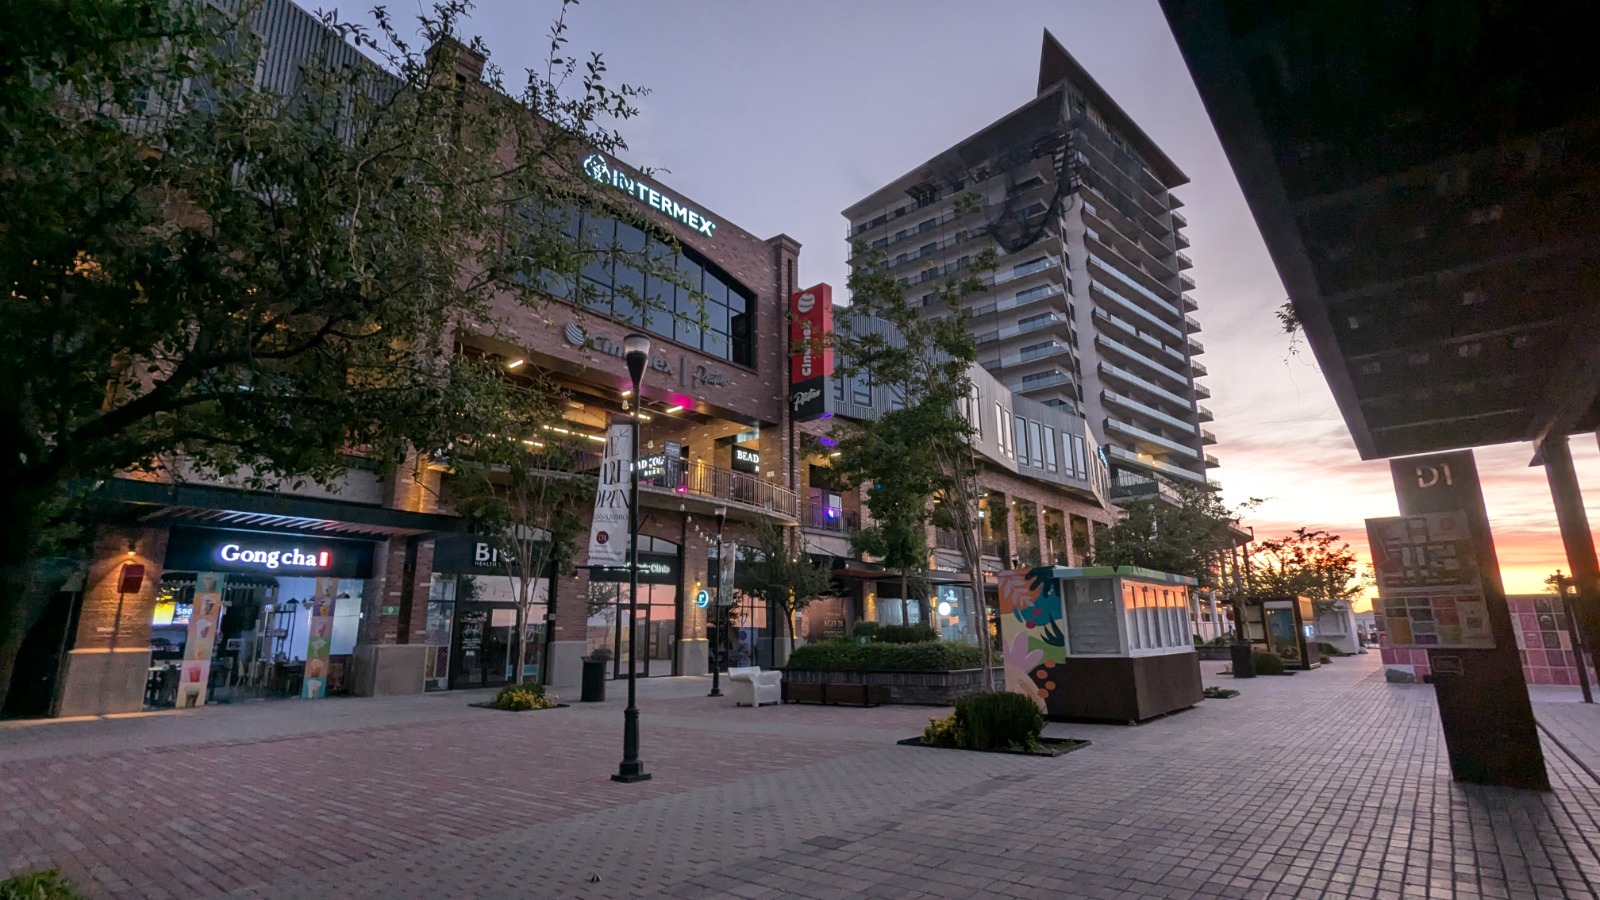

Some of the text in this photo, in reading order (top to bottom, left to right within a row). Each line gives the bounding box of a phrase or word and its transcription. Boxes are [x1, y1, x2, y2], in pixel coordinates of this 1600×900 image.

[612, 168, 714, 238] INTERMEX
[1416, 462, 1453, 488] D1
[221, 544, 280, 568] Gong
[281, 548, 317, 567] cha
